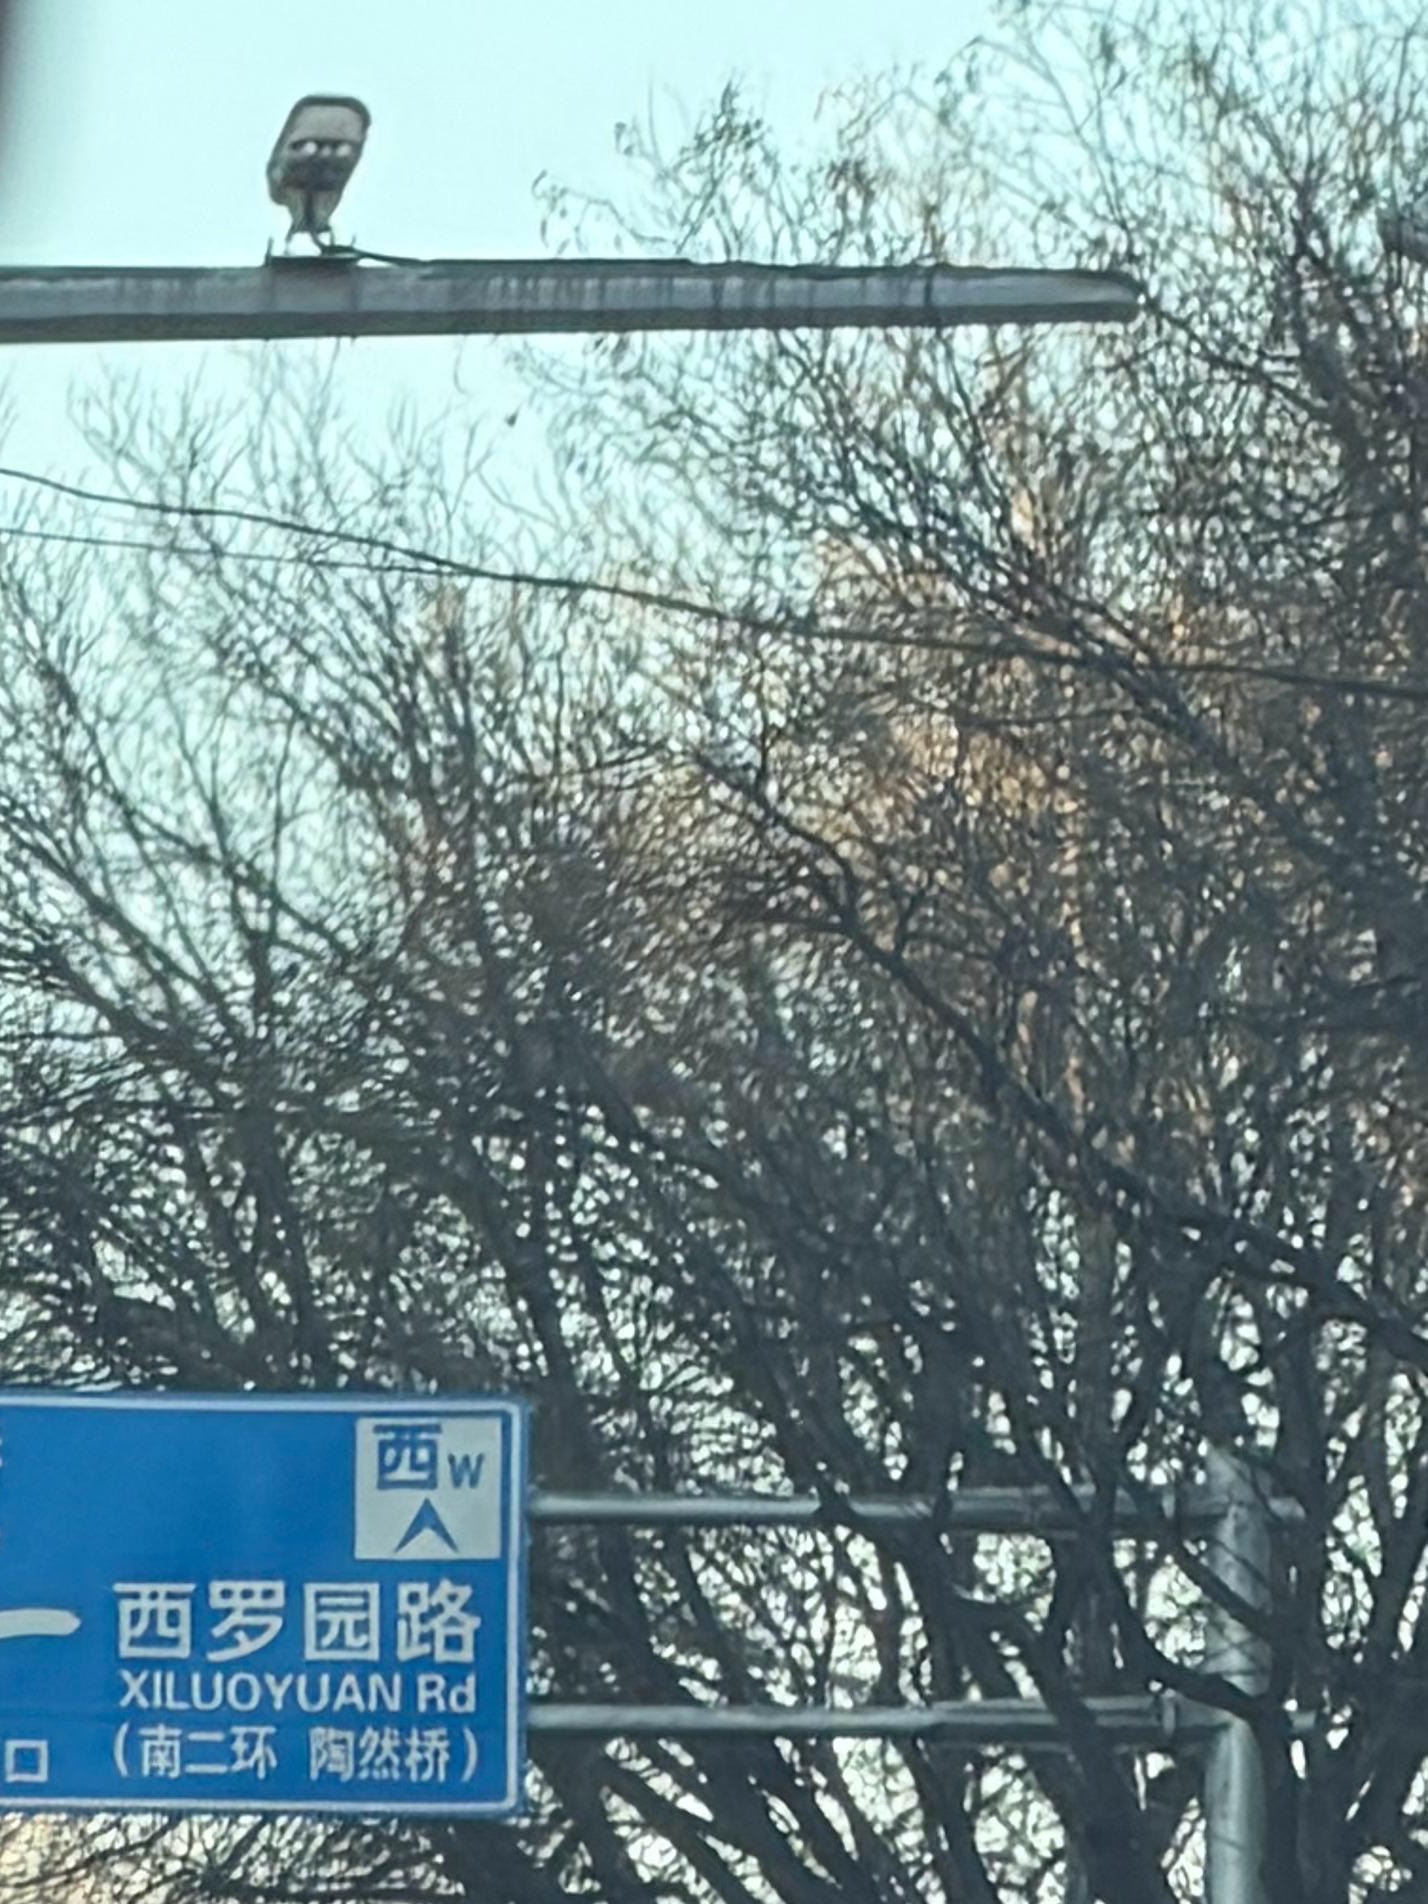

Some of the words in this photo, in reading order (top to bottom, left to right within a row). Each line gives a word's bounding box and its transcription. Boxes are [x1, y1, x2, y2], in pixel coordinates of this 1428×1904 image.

[374, 1423, 443, 1492] 西
[447, 1452, 485, 1490] W
[112, 1579, 482, 1665] 西罗园路
[118, 1669, 402, 1713] XILUOYUAN
[417, 1671, 477, 1714] Rd
